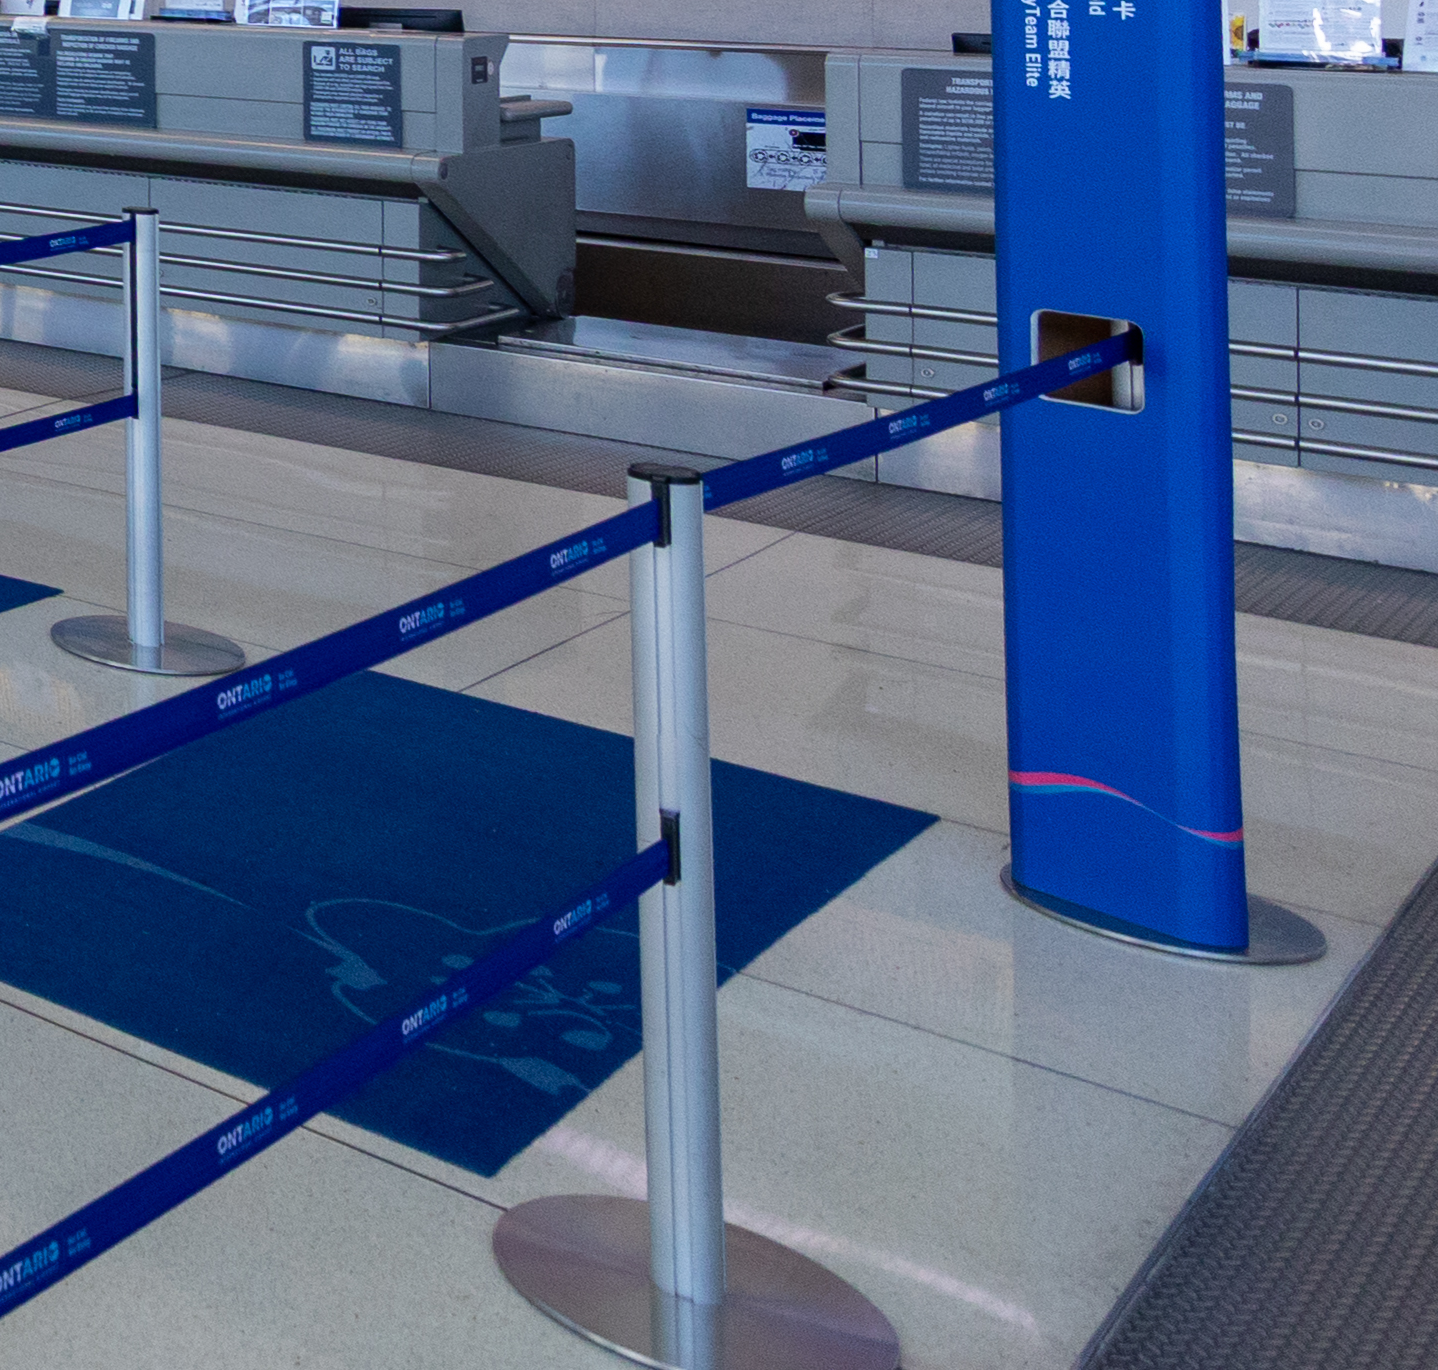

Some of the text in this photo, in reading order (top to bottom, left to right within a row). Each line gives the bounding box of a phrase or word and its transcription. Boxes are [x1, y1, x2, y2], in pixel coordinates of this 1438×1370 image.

[338, 47, 378, 57] ALL BAGS
[338, 55, 394, 66] ARE SUBJECT
[339, 63, 385, 73] TO SEARCH
[1025, 52, 1042, 88] Elite
[750, 112, 788, 123] Baggage
[216, 673, 273, 710] ONTARIO
[216, 1105, 274, 1156] ONTARIO
